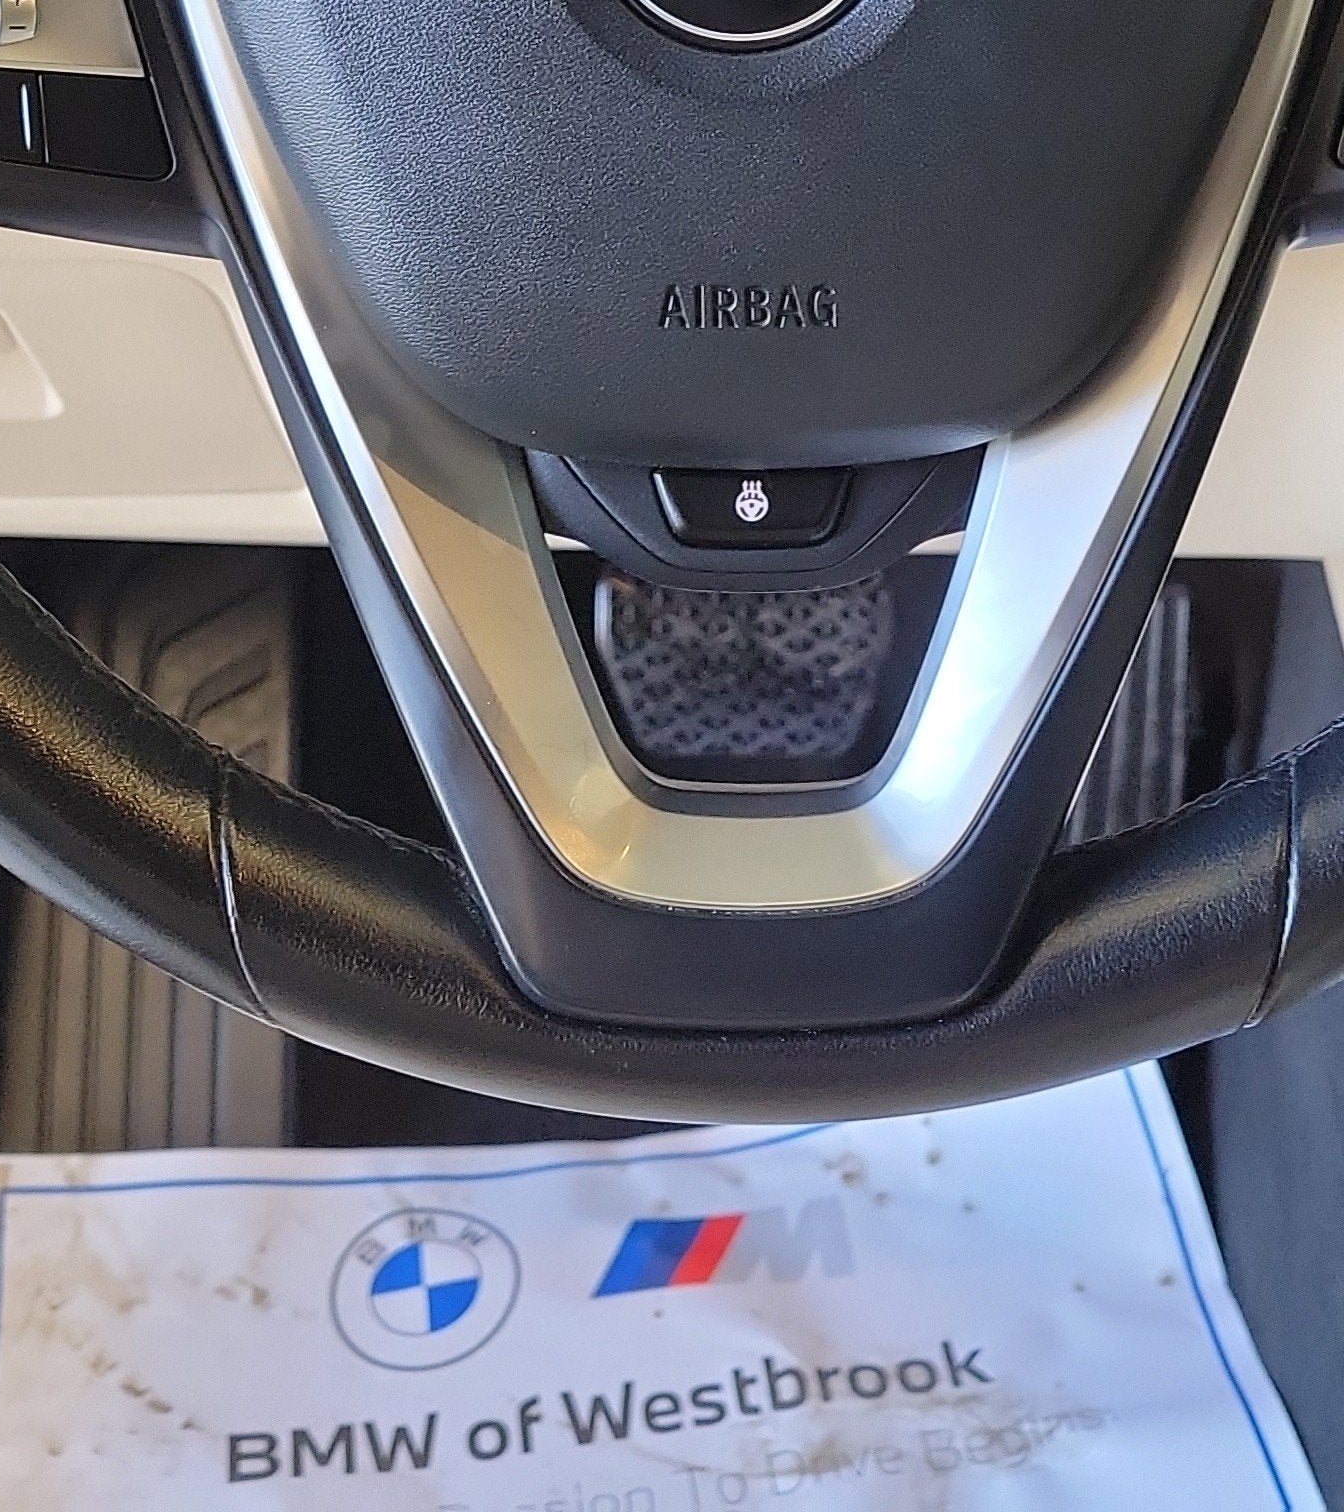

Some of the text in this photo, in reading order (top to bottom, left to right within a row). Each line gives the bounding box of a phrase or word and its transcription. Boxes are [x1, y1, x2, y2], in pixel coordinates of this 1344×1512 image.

[659, 284, 839, 329] AIRBAG
[357, 1213, 489, 1264] BMW
[229, 1339, 994, 1482] BMW of Westbrook
[674, 1462, 749, 1512] To
